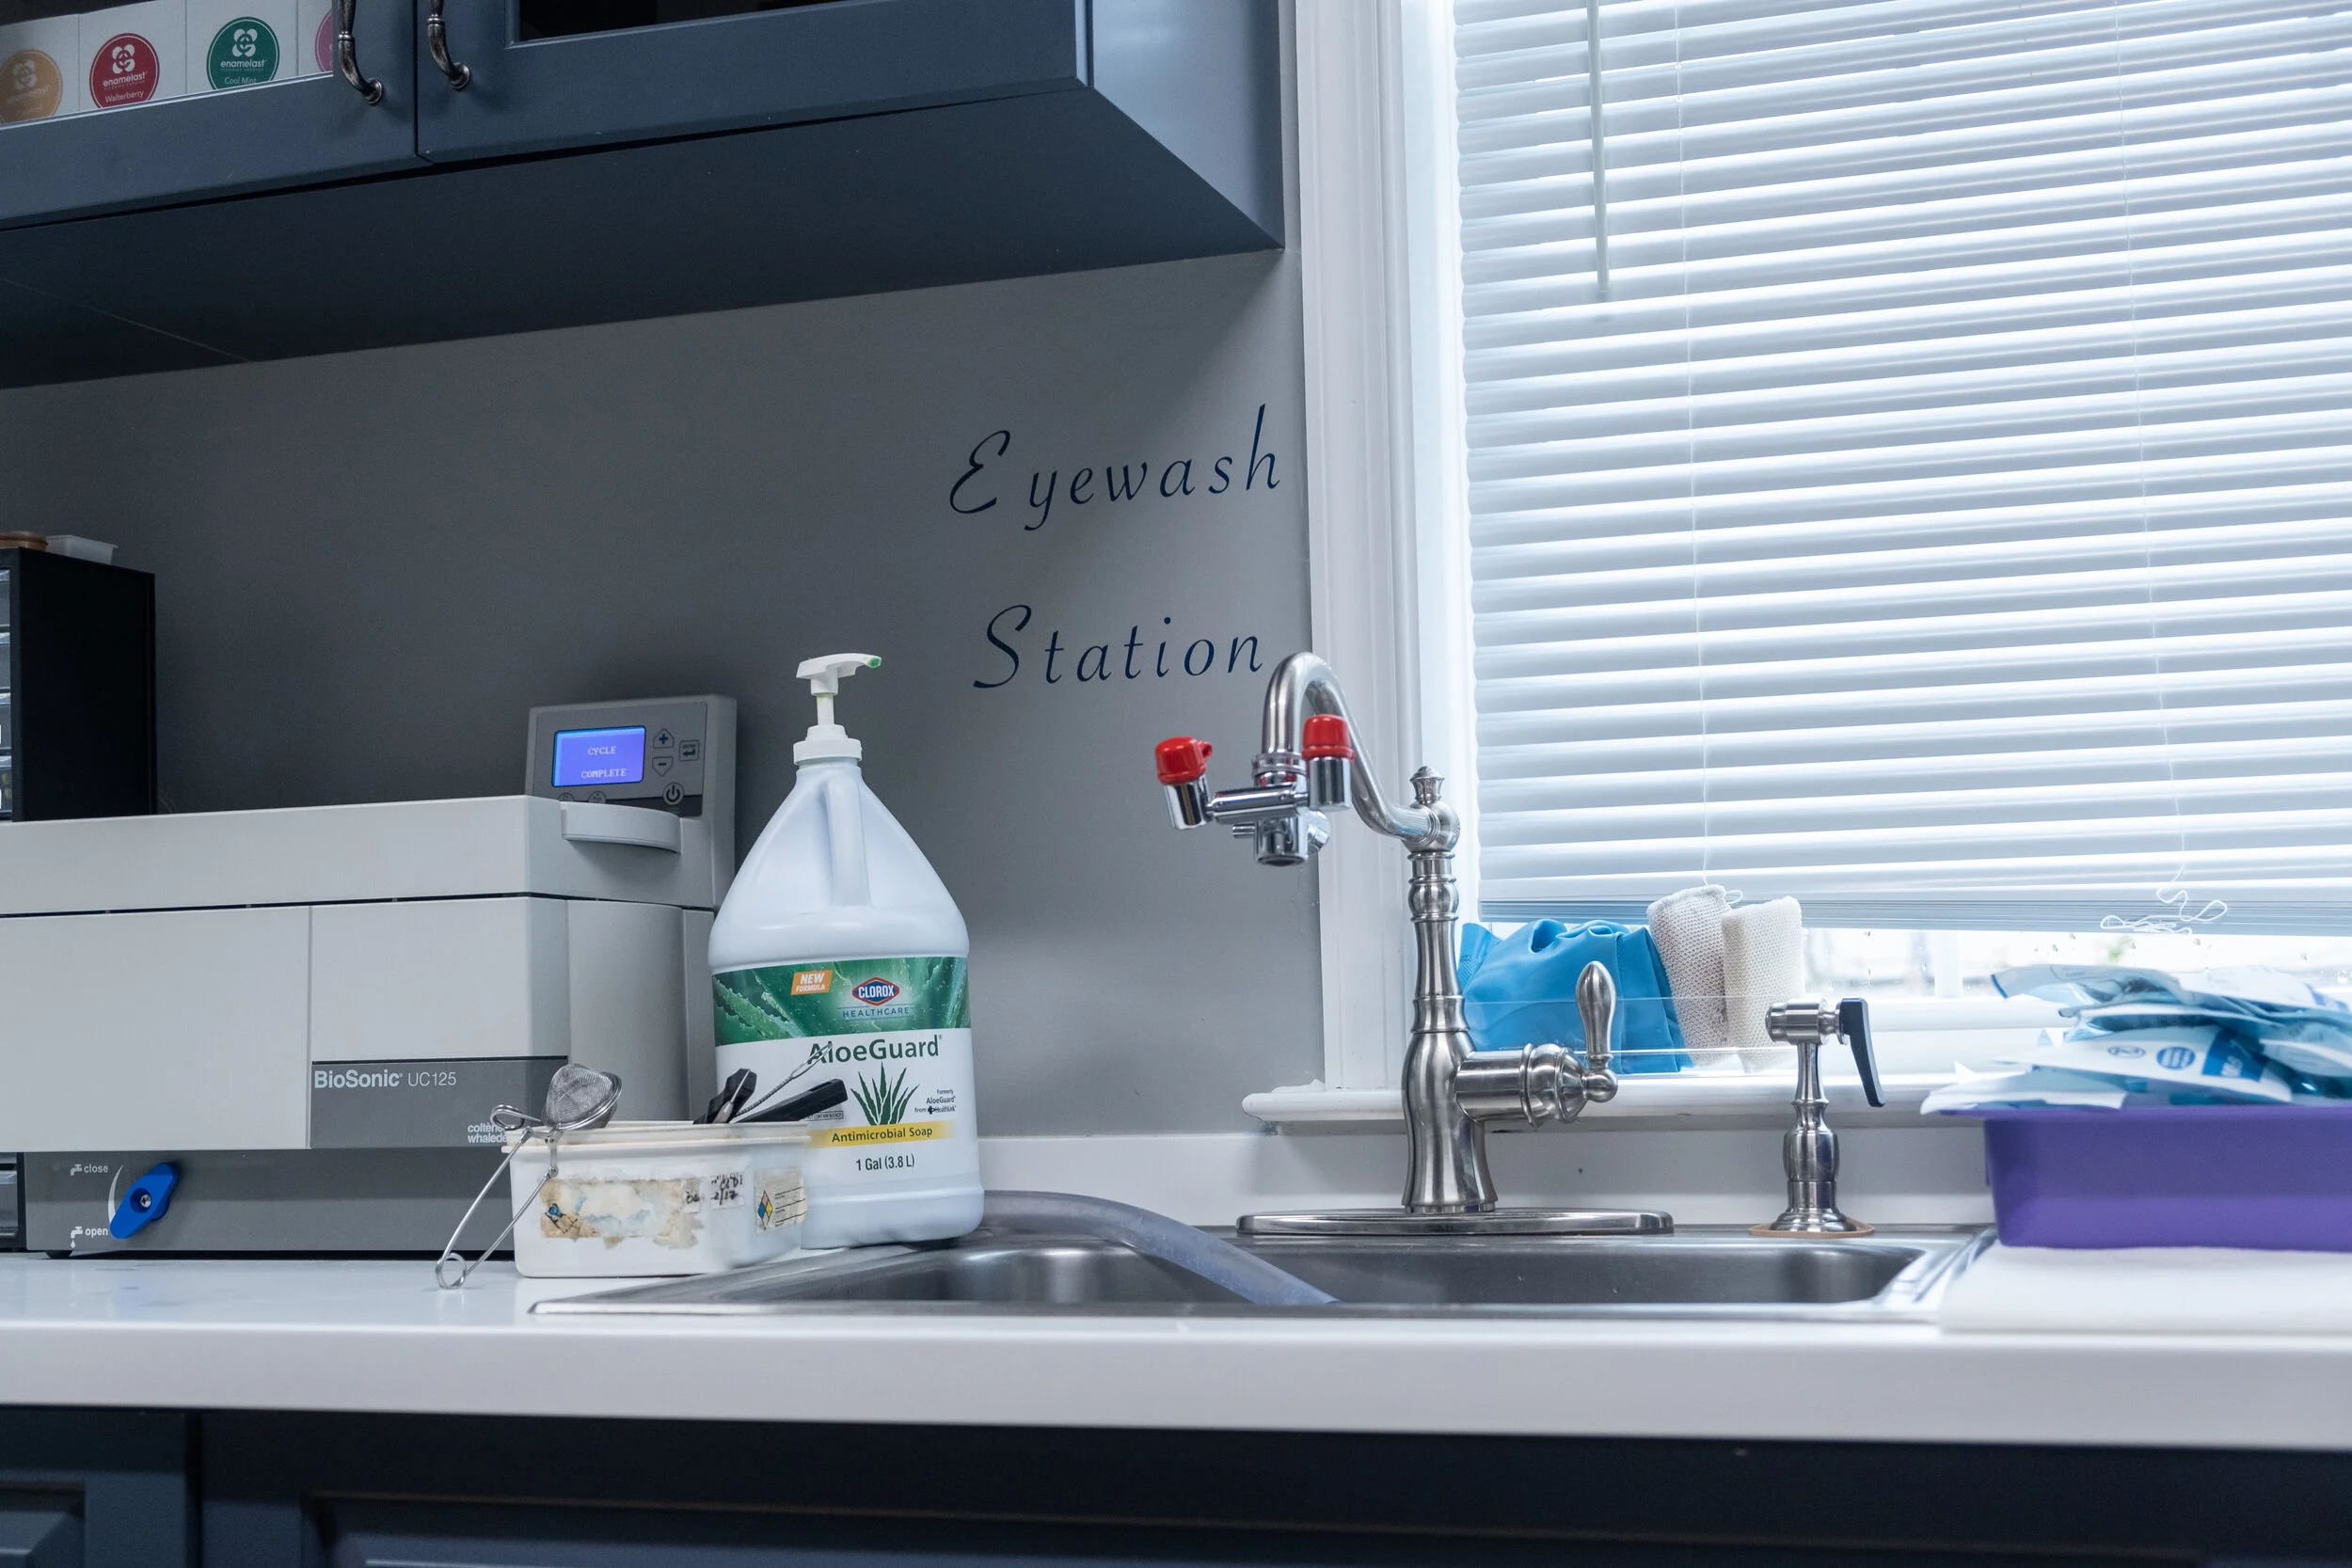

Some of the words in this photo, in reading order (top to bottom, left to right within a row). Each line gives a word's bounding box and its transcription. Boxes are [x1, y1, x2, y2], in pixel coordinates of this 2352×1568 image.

[220, 59, 265, 68] enamelast
[103, 71, 146, 87] enamelast
[224, 76, 240, 85] Cool
[104, 90, 144, 103] Walterberry
[949, 404, 1280, 531] Eyewash
[973, 605, 1263, 688] Station
[587, 746, 617, 755] CYCLE
[580, 768, 628, 779] COMPLETE
[800, 972, 825, 984] NEW
[795, 984, 826, 992] FORMULA
[858, 985, 895, 999] CLOROX
[843, 1006, 910, 1018] HEALTHCARE
[807, 1034, 939, 1065] AloeGuard
[407, 1071, 457, 1086] UC125
[832, 1127, 906, 1143] Antimicrobial
[909, 1127, 933, 1138] Soap
[855, 1158, 862, 1171] 1
[865, 1157, 882, 1171] Gal
[884, 1154, 904, 1169] (3.8
[905, 1153, 915, 1167] L)
[84, 1164, 109, 1173] close
[85, 1227, 109, 1237] open
